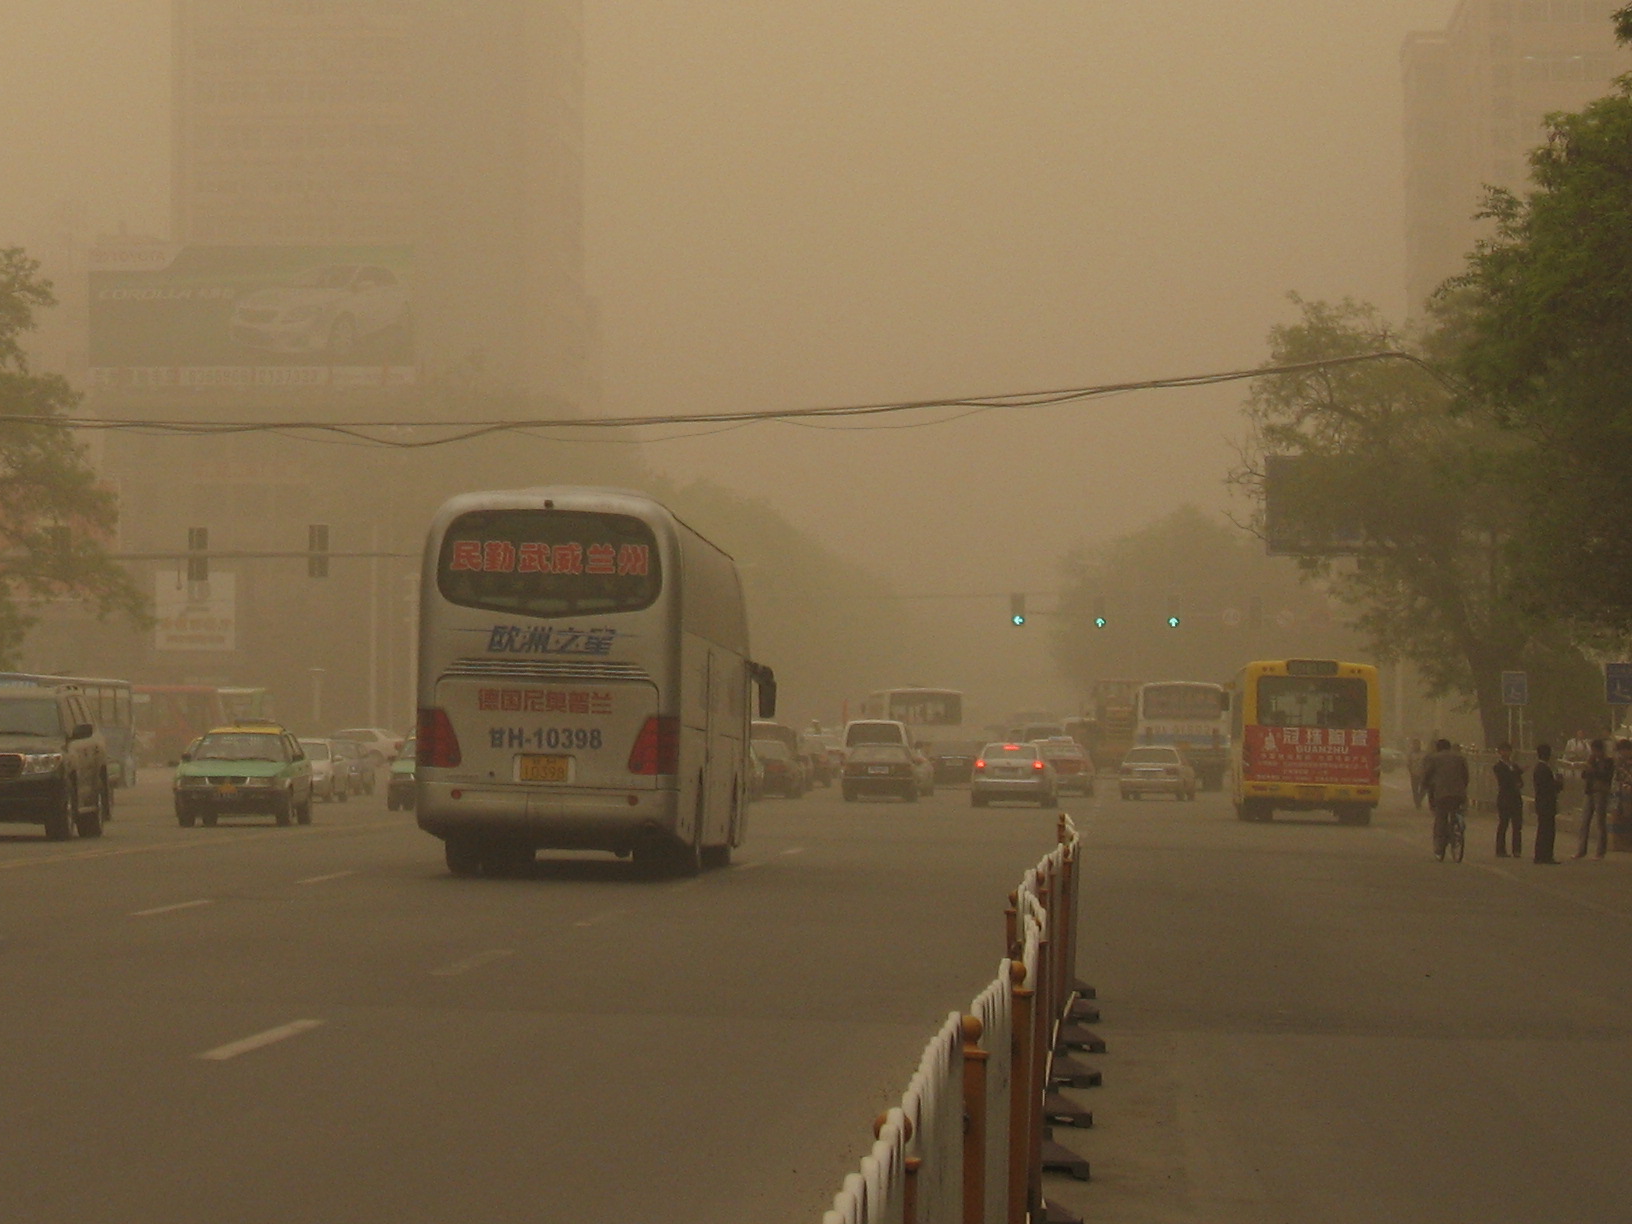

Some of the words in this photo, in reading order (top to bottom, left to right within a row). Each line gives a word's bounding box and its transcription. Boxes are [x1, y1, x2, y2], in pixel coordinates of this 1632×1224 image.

[99, 288, 193, 301] COROLLA
[451, 542, 649, 575] 民勤武威兰州
[488, 625, 617, 655] 欧洲之星
[479, 688, 612, 714] 德国尼奥普兰
